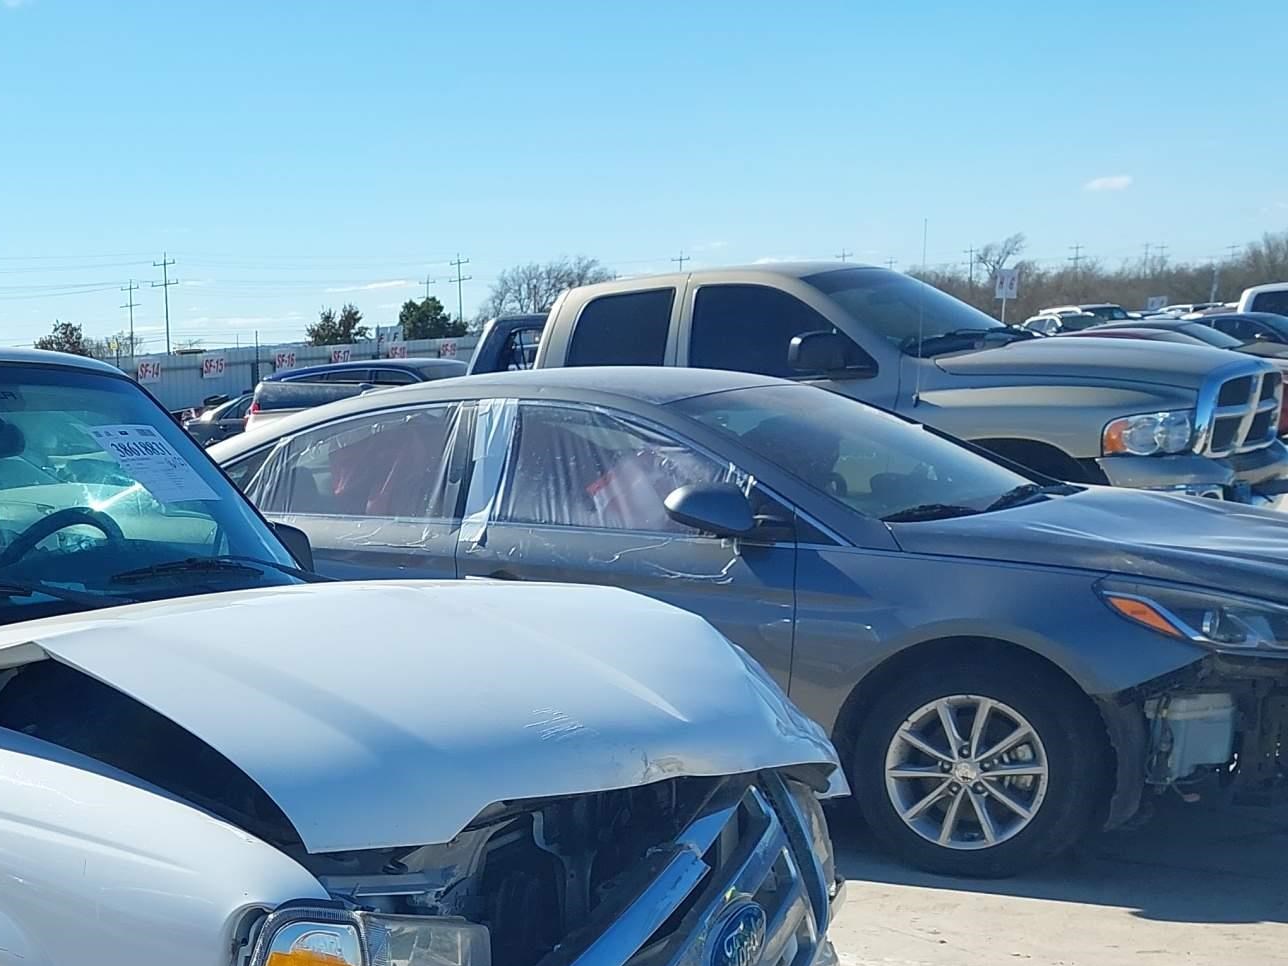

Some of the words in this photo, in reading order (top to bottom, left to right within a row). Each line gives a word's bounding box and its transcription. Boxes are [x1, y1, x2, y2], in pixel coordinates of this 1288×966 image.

[139, 363, 161, 379] SF-14
[204, 358, 225, 374] SF-15
[110, 441, 173, 458] 38618831
